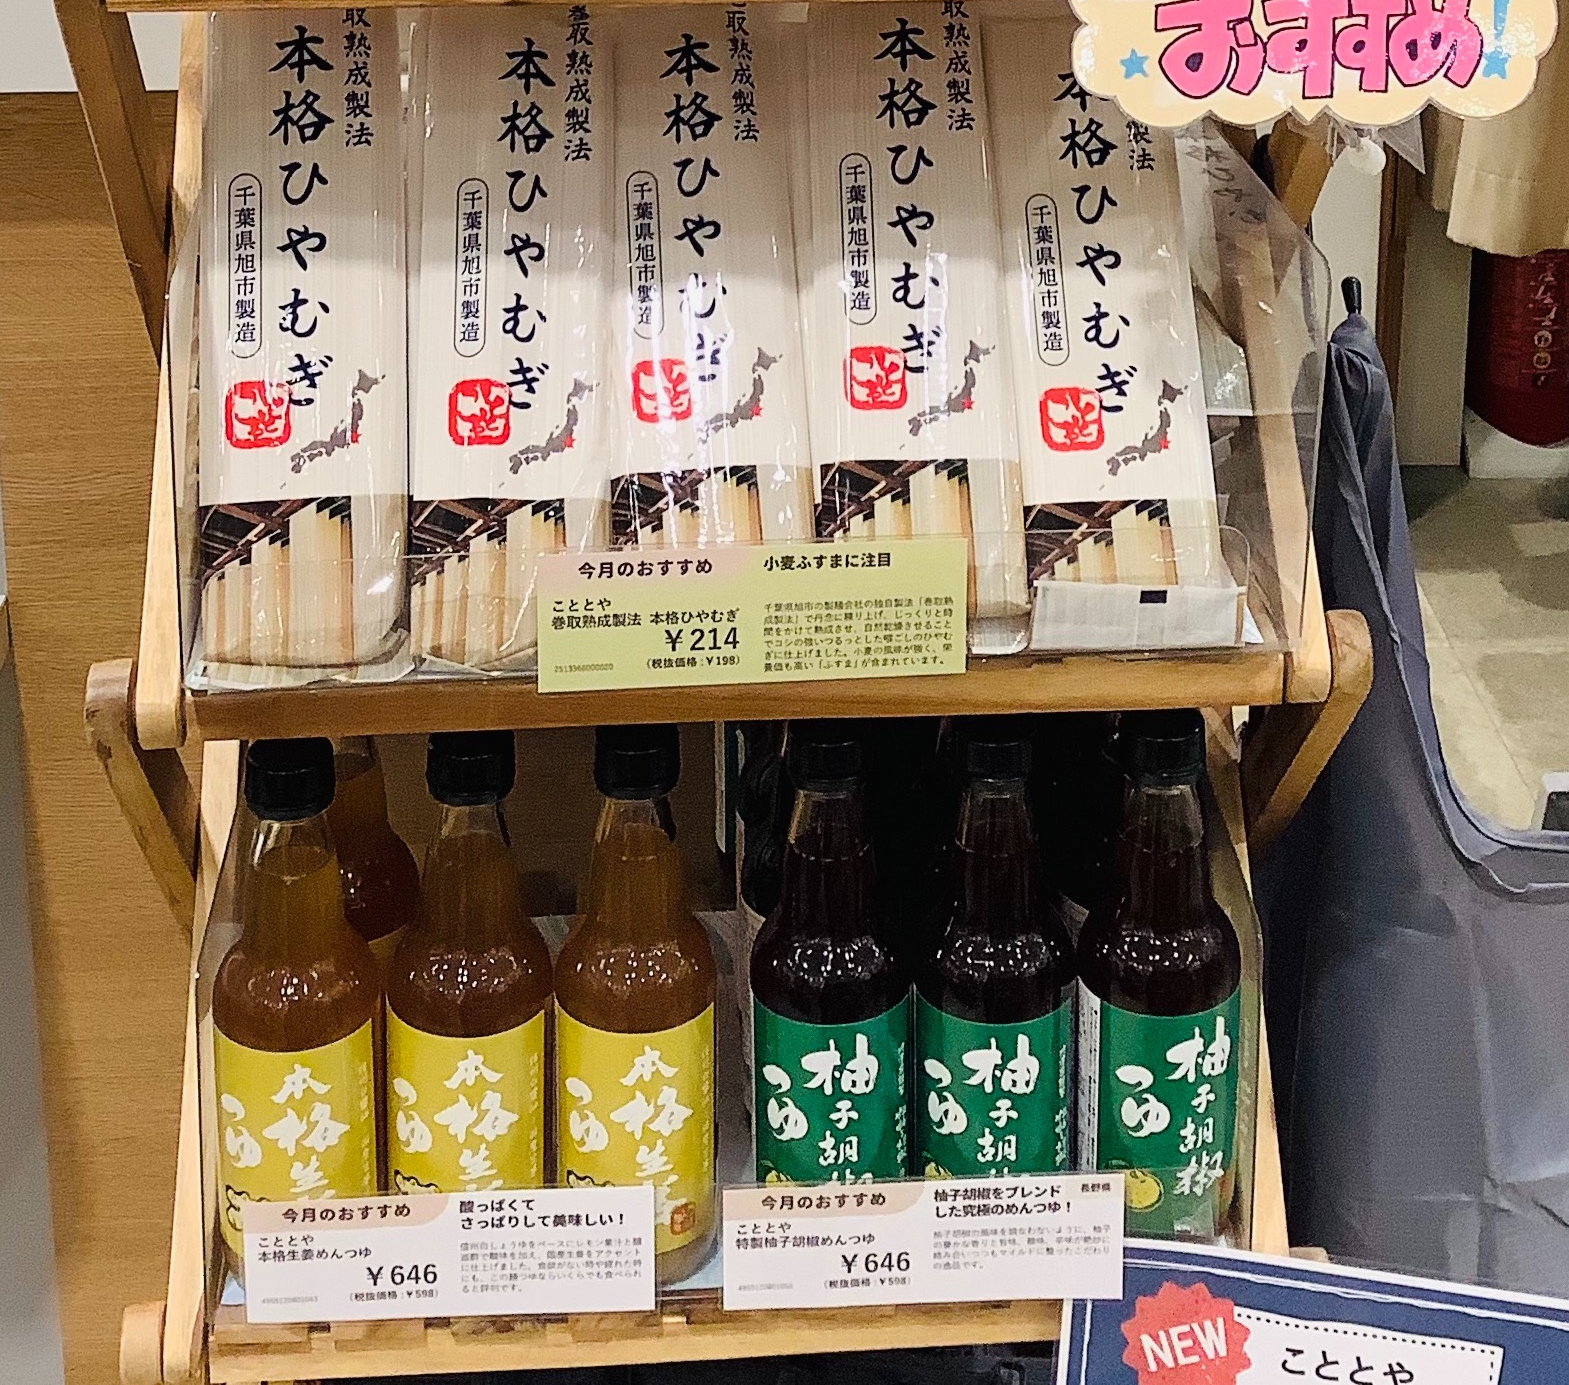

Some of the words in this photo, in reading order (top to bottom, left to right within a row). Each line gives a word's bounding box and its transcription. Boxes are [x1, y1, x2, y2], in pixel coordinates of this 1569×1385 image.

[268, 25, 335, 407] 本格ひやむぎ
[497, 38, 555, 410] 本格ひやむぎ
[873, 17, 939, 373] 本格ひやむぎ
[234, 185, 257, 343] 千葉県旭市製造
[459, 191, 484, 343] 千葉県旭市製造
[844, 164, 871, 311] 千葉県旭市製造
[1032, 205, 1064, 352] 千葉県旭市製造
[578, 558, 713, 580] 今月のおすすめ
[763, 552, 891, 572] 小麦ふすまに注目
[551, 613, 642, 630] 巻取熟成製法
[650, 608, 739, 626] 本格ひやむぎ
[552, 598, 612, 613] こととや
[665, 627, 740, 652] ¥214
[220, 1093, 263, 1169] つゆ
[262, 1063, 350, 1202] 本格生
[393, 1077, 433, 1155] つゆ
[432, 1049, 519, 1191] 本格生
[565, 1076, 610, 1154] つゆ
[762, 1064, 808, 1142] つゆ
[924, 1058, 967, 1135] つゆ
[962, 1034, 1041, 1178] 柚子胡
[1115, 1064, 1171, 1138] つゆ
[281, 1202, 411, 1224] 今月のおすすめ
[737, 1222, 792, 1235] こととや
[762, 1193, 886, 1210] 今月のおすすめ
[934, 1184, 1061, 1202] 柚子胡椒をブレンド
[258, 1234, 314, 1248] こととや
[258, 1246, 372, 1262] 本格生姜めんつゆ
[366, 1264, 438, 1286] ¥646
[841, 1251, 911, 1274] ¥646
[1141, 1315, 1228, 1372] NEW
[1281, 1347, 1414, 1385] こととや
